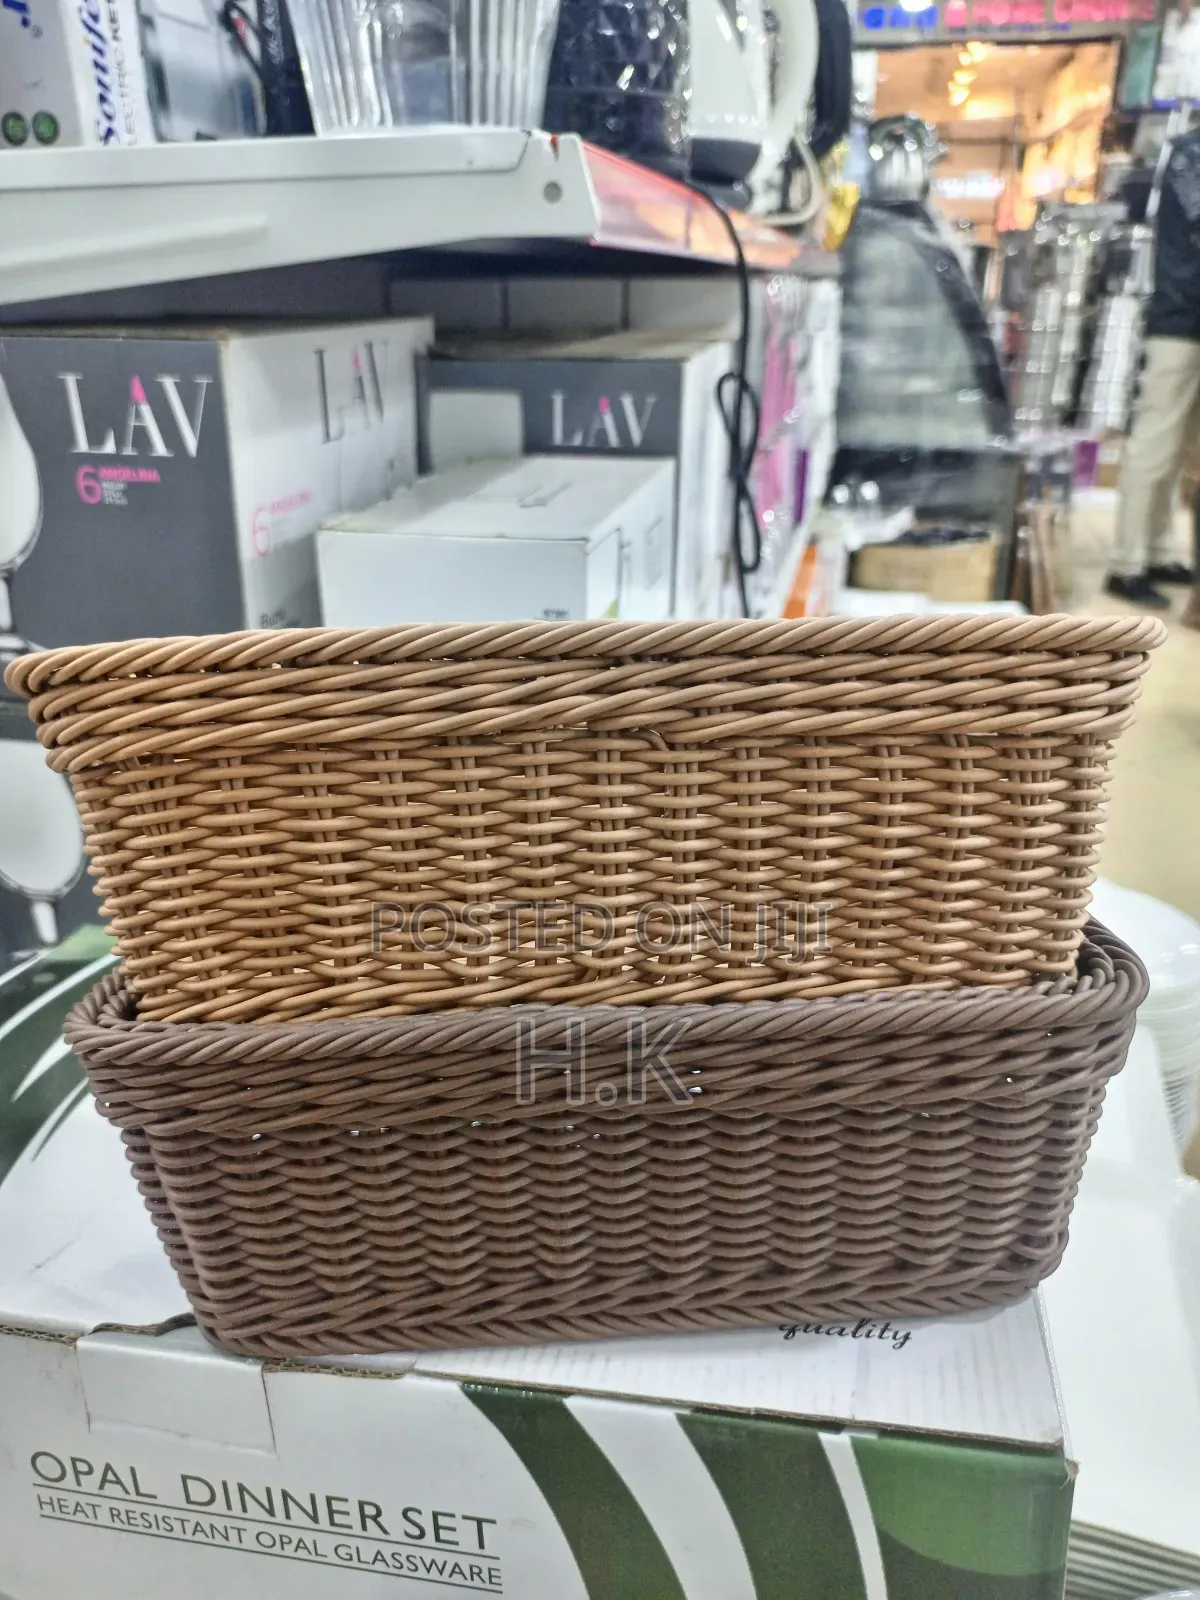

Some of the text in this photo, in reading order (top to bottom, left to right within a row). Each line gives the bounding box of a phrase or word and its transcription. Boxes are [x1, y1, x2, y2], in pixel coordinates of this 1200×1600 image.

[57, 372, 214, 458] LAV
[313, 338, 388, 445] LAV
[551, 390, 657, 448] LAV
[76, 465, 102, 504] 6
[252, 505, 271, 558] 6
[778, 1317, 912, 1349] quality
[30, 1450, 497, 1550] OPAL DINNER SET
[37, 1494, 502, 1587] HEAT RESISTANT OPAL GLASSWARE
